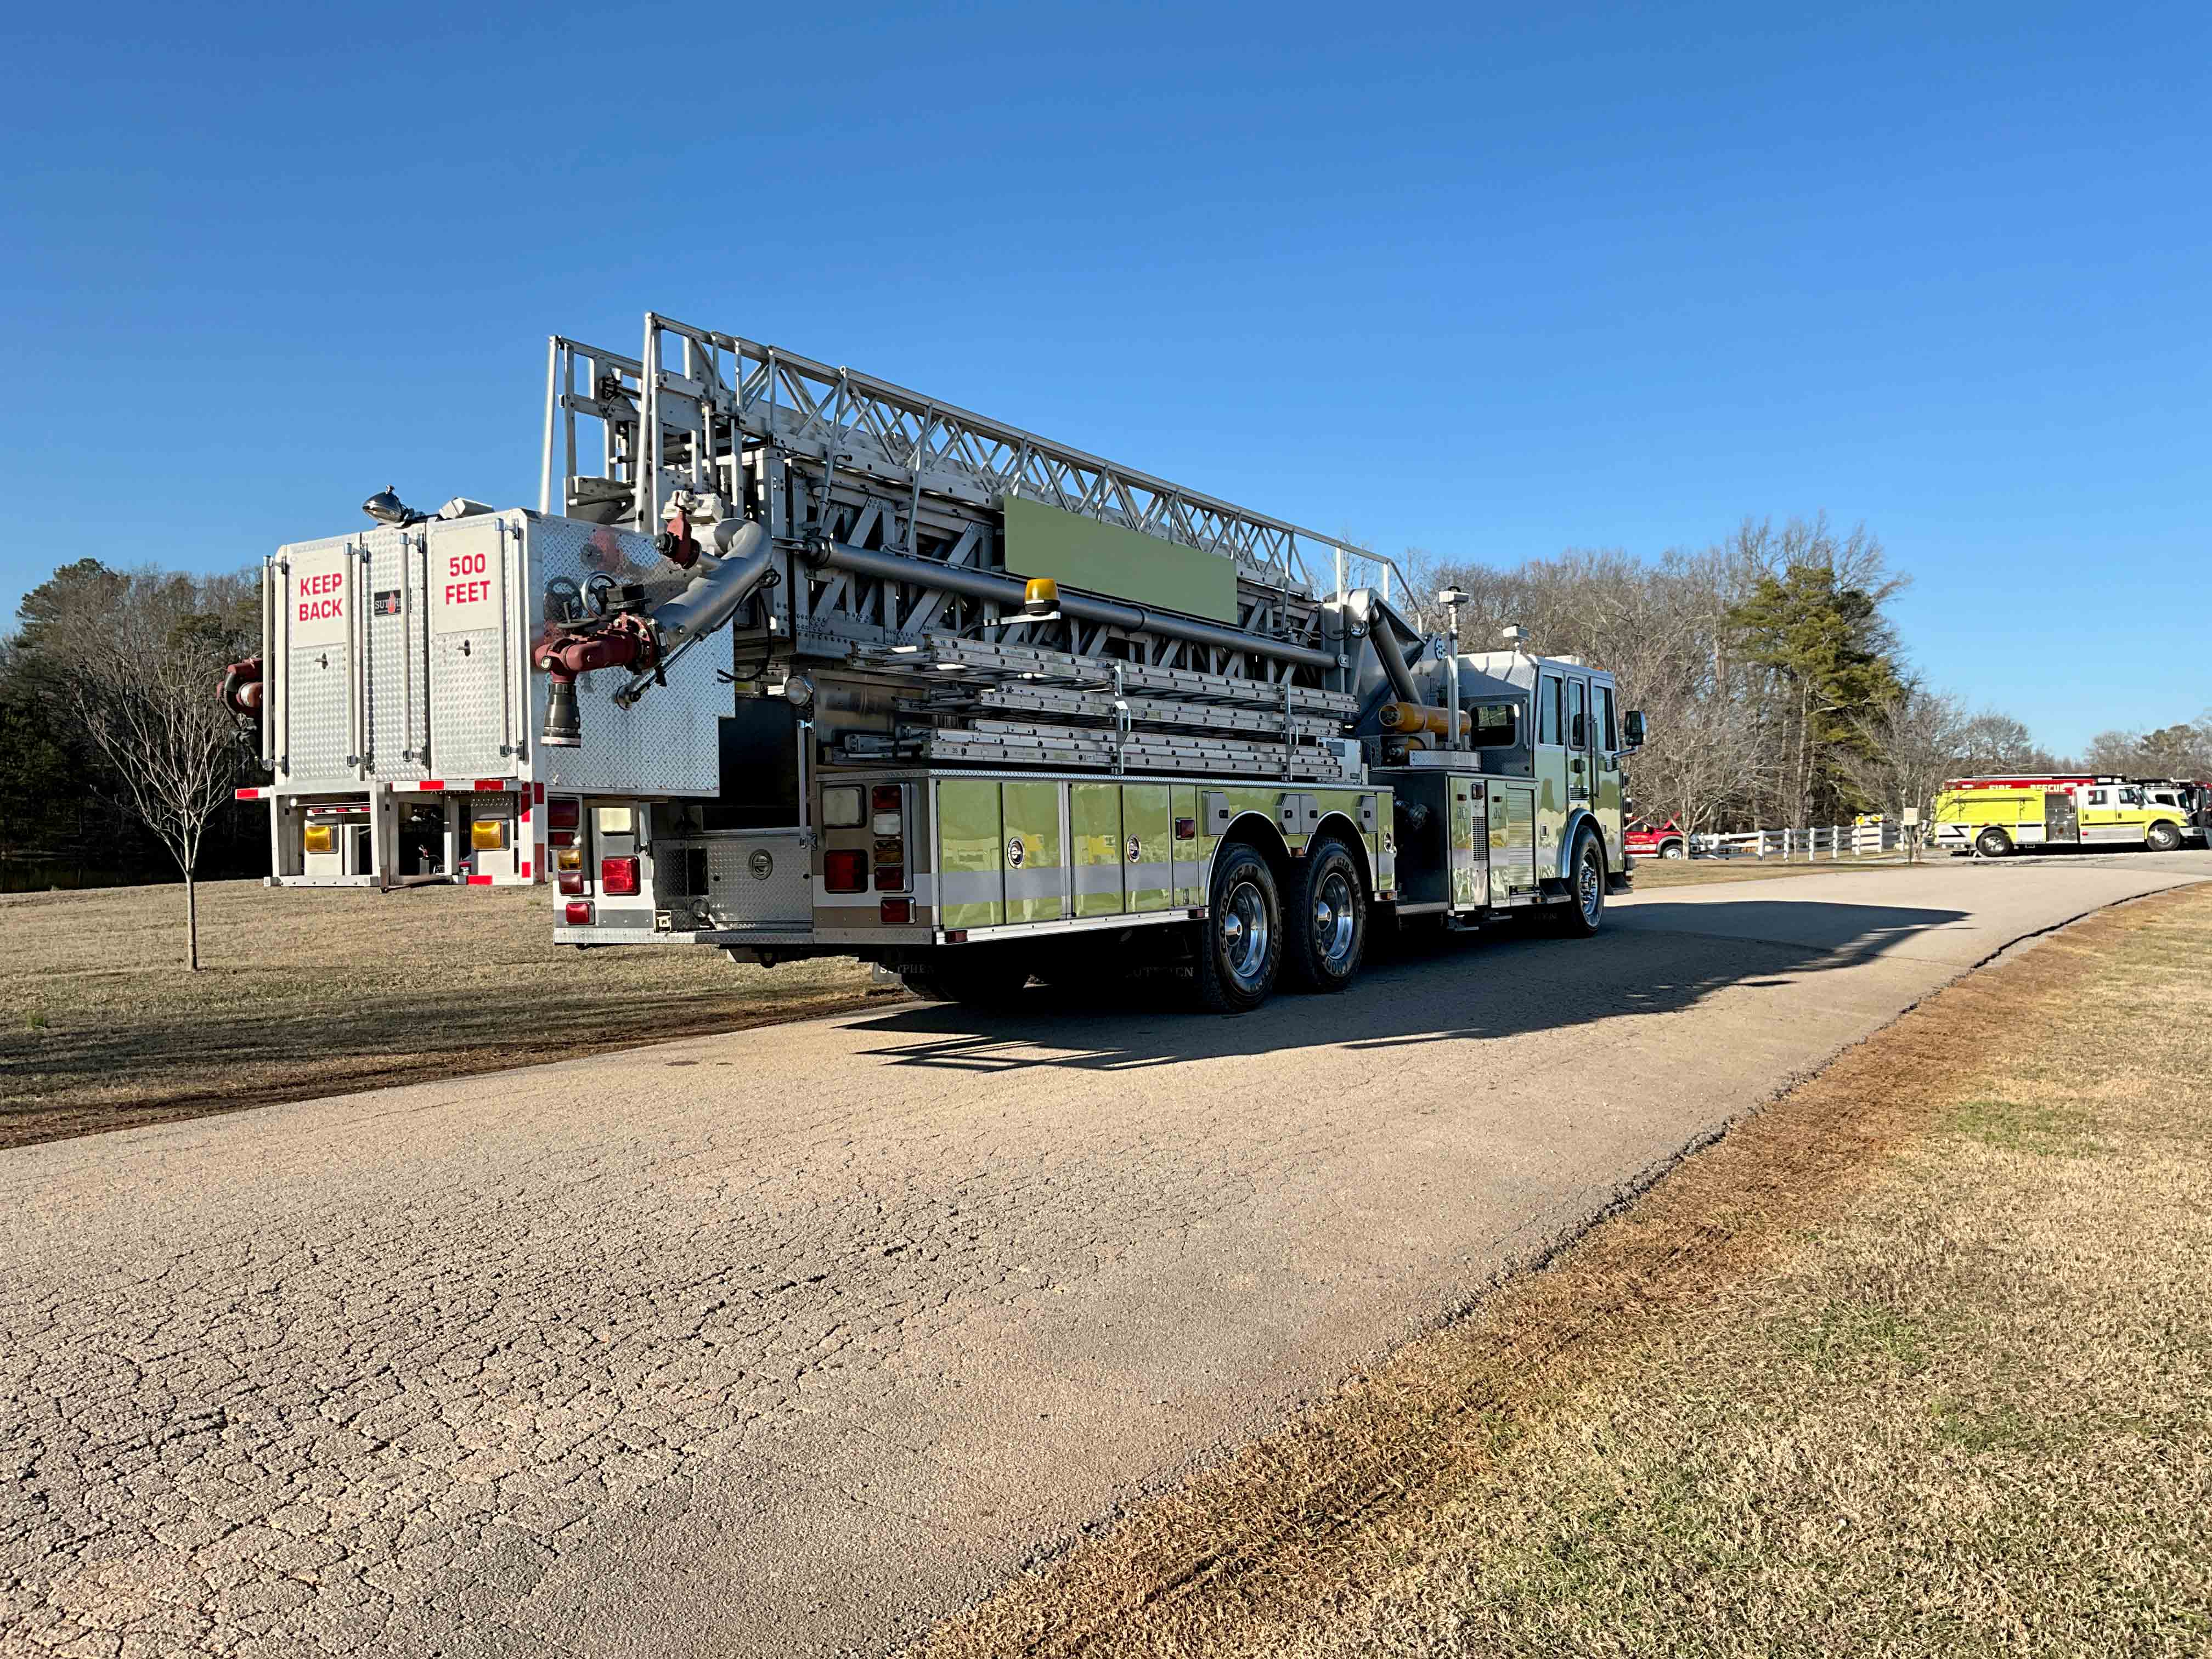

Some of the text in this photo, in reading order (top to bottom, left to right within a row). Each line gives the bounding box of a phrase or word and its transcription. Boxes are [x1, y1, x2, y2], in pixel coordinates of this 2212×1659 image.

[449, 553, 486, 577] 500
[300, 573, 342, 597] KEEP
[445, 580, 491, 605] FEET
[299, 597, 343, 621] BACK
